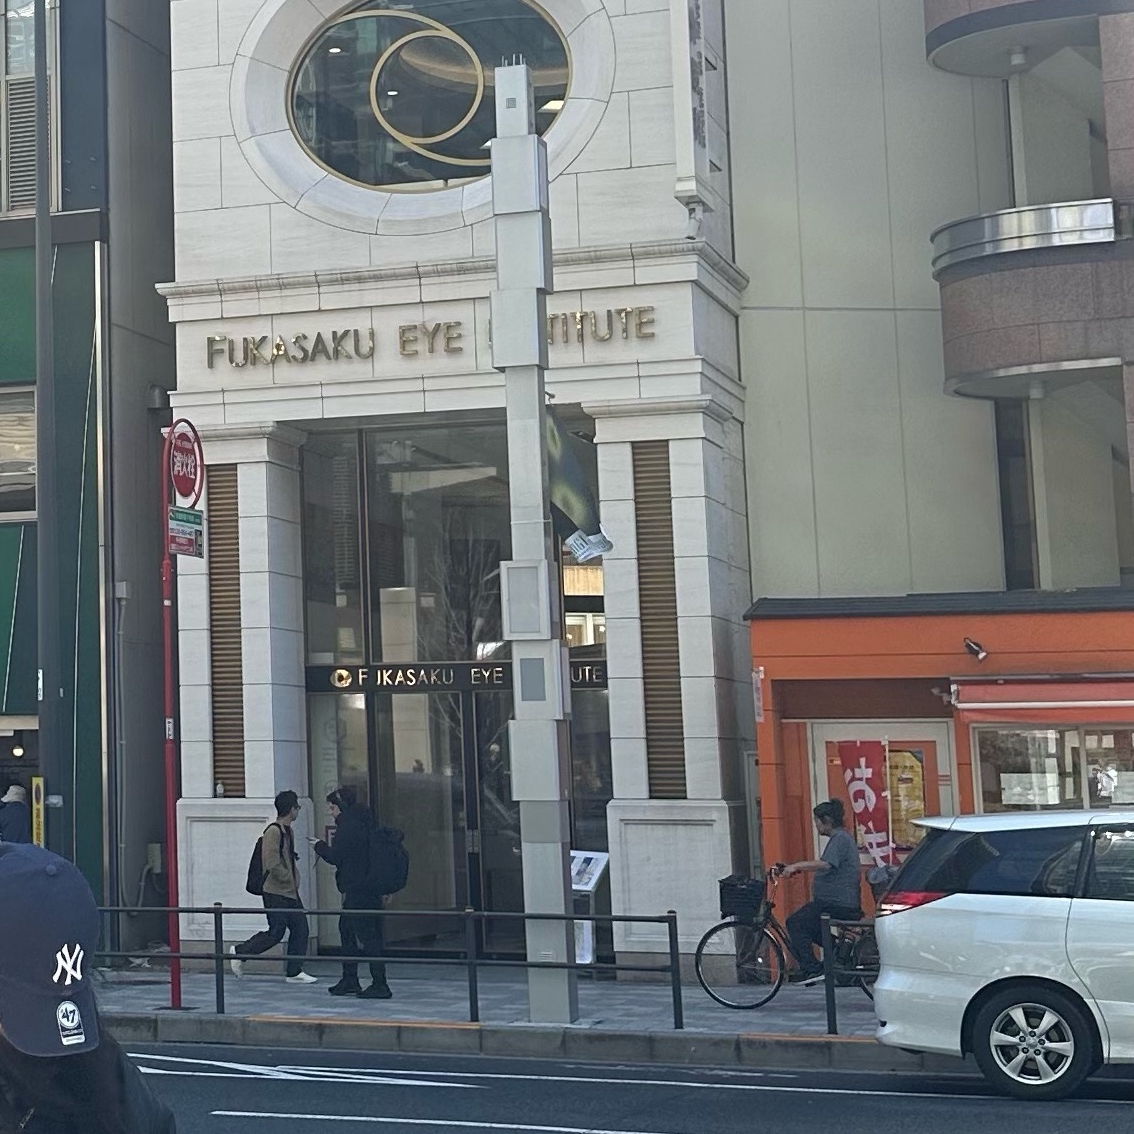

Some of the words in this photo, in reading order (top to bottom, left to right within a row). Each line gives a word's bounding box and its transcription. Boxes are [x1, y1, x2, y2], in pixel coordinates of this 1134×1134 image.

[207, 328, 375, 368] FUKASAKU
[399, 321, 463, 355] EYE
[173, 451, 196, 480] 消火栓
[471, 667, 504, 684] EYE
[52, 943, 85, 985] NY
